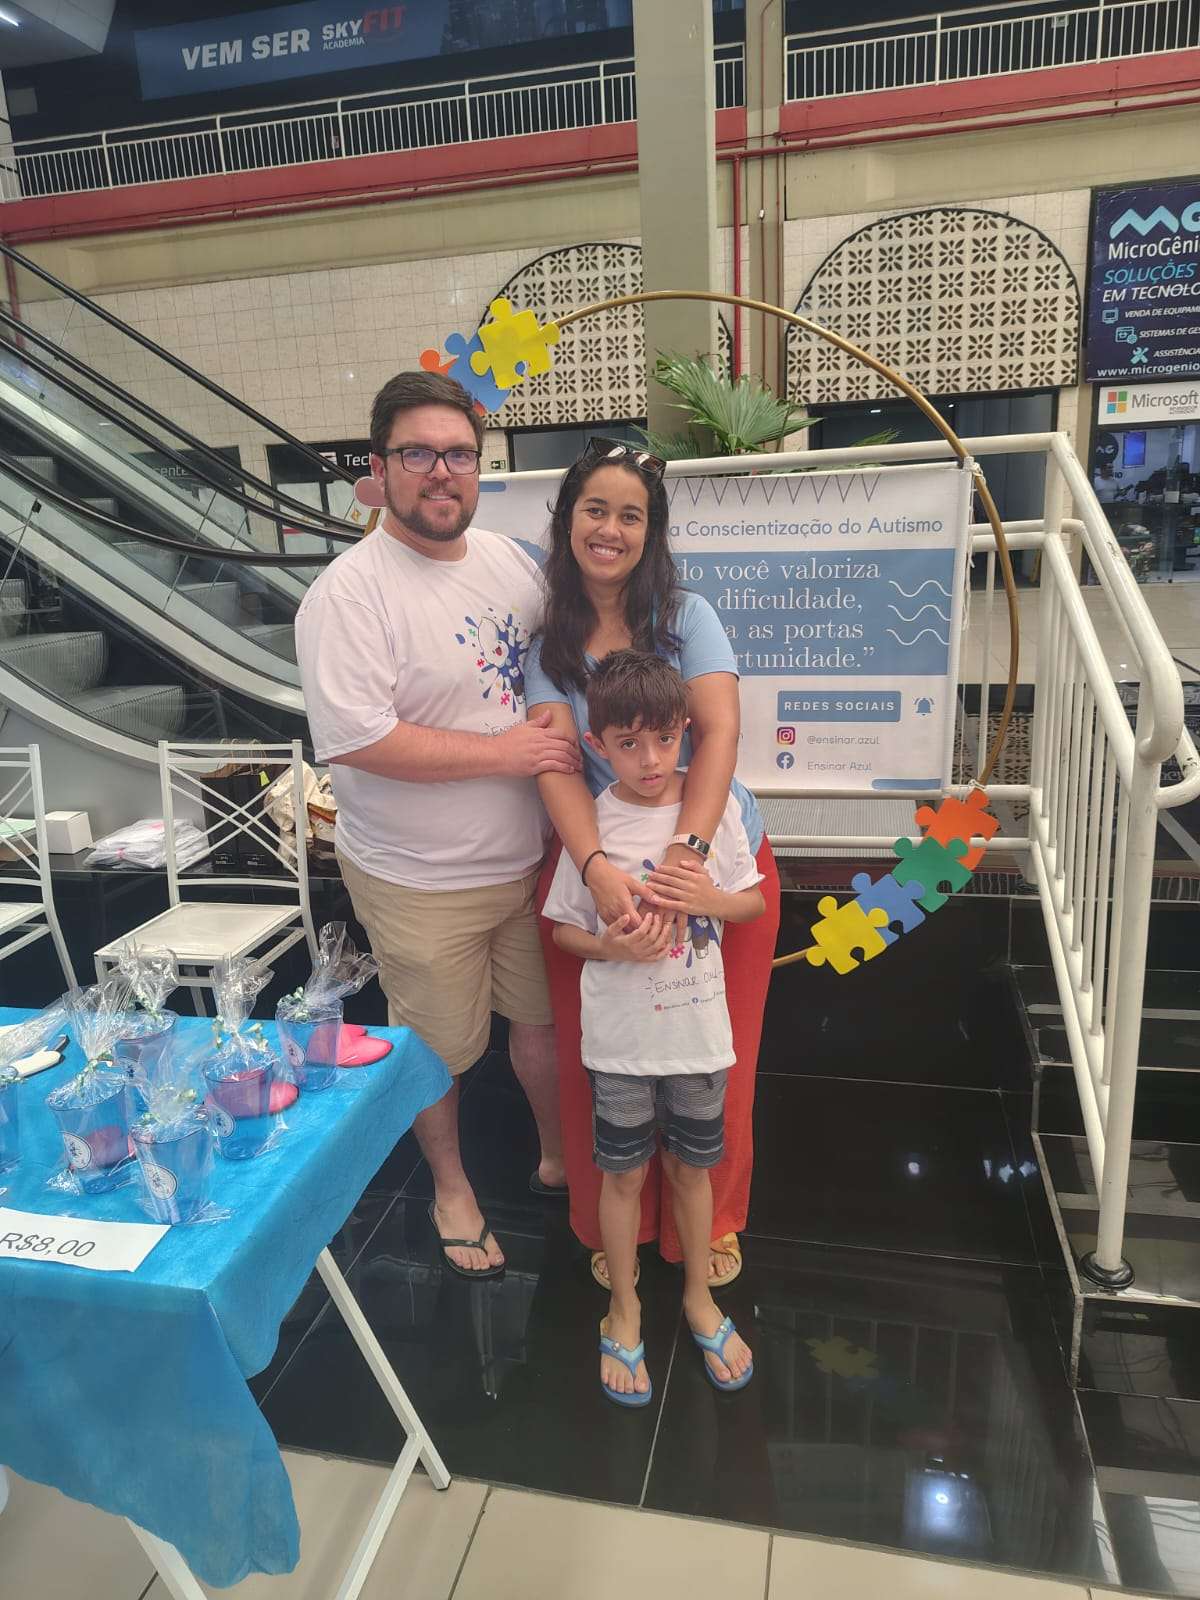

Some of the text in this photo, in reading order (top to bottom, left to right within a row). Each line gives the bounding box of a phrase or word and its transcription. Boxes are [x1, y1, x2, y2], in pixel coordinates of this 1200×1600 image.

[181, 39, 243, 71] VEM
[251, 28, 311, 60] SER
[322, 36, 366, 51] ACADEMIA
[1108, 235, 1200, 261] MicroGêni
[1103, 260, 1198, 285] SOLUÇÕES
[1102, 288, 1127, 303] EM
[1124, 308, 1151, 319] VENDA
[1151, 307, 1163, 317] DE
[1138, 328, 1176, 339] SISTEMAS
[1176, 326, 1188, 336] DE
[1131, 389, 1199, 409] Microsoft
[685, 518, 833, 539] Conscientização
[837, 517, 863, 535] do
[866, 515, 944, 534] Autismo
[713, 559, 770, 582] você
[780, 556, 881, 580] valoriza
[716, 586, 864, 613] dificuldade,
[748, 622, 774, 640] as
[783, 620, 864, 645] portas
[783, 701, 895, 711] REDES SOCIAIS
[807, 761, 873, 772] Ensinar Azul
[0, 1232, 96, 1257] R$8,00
